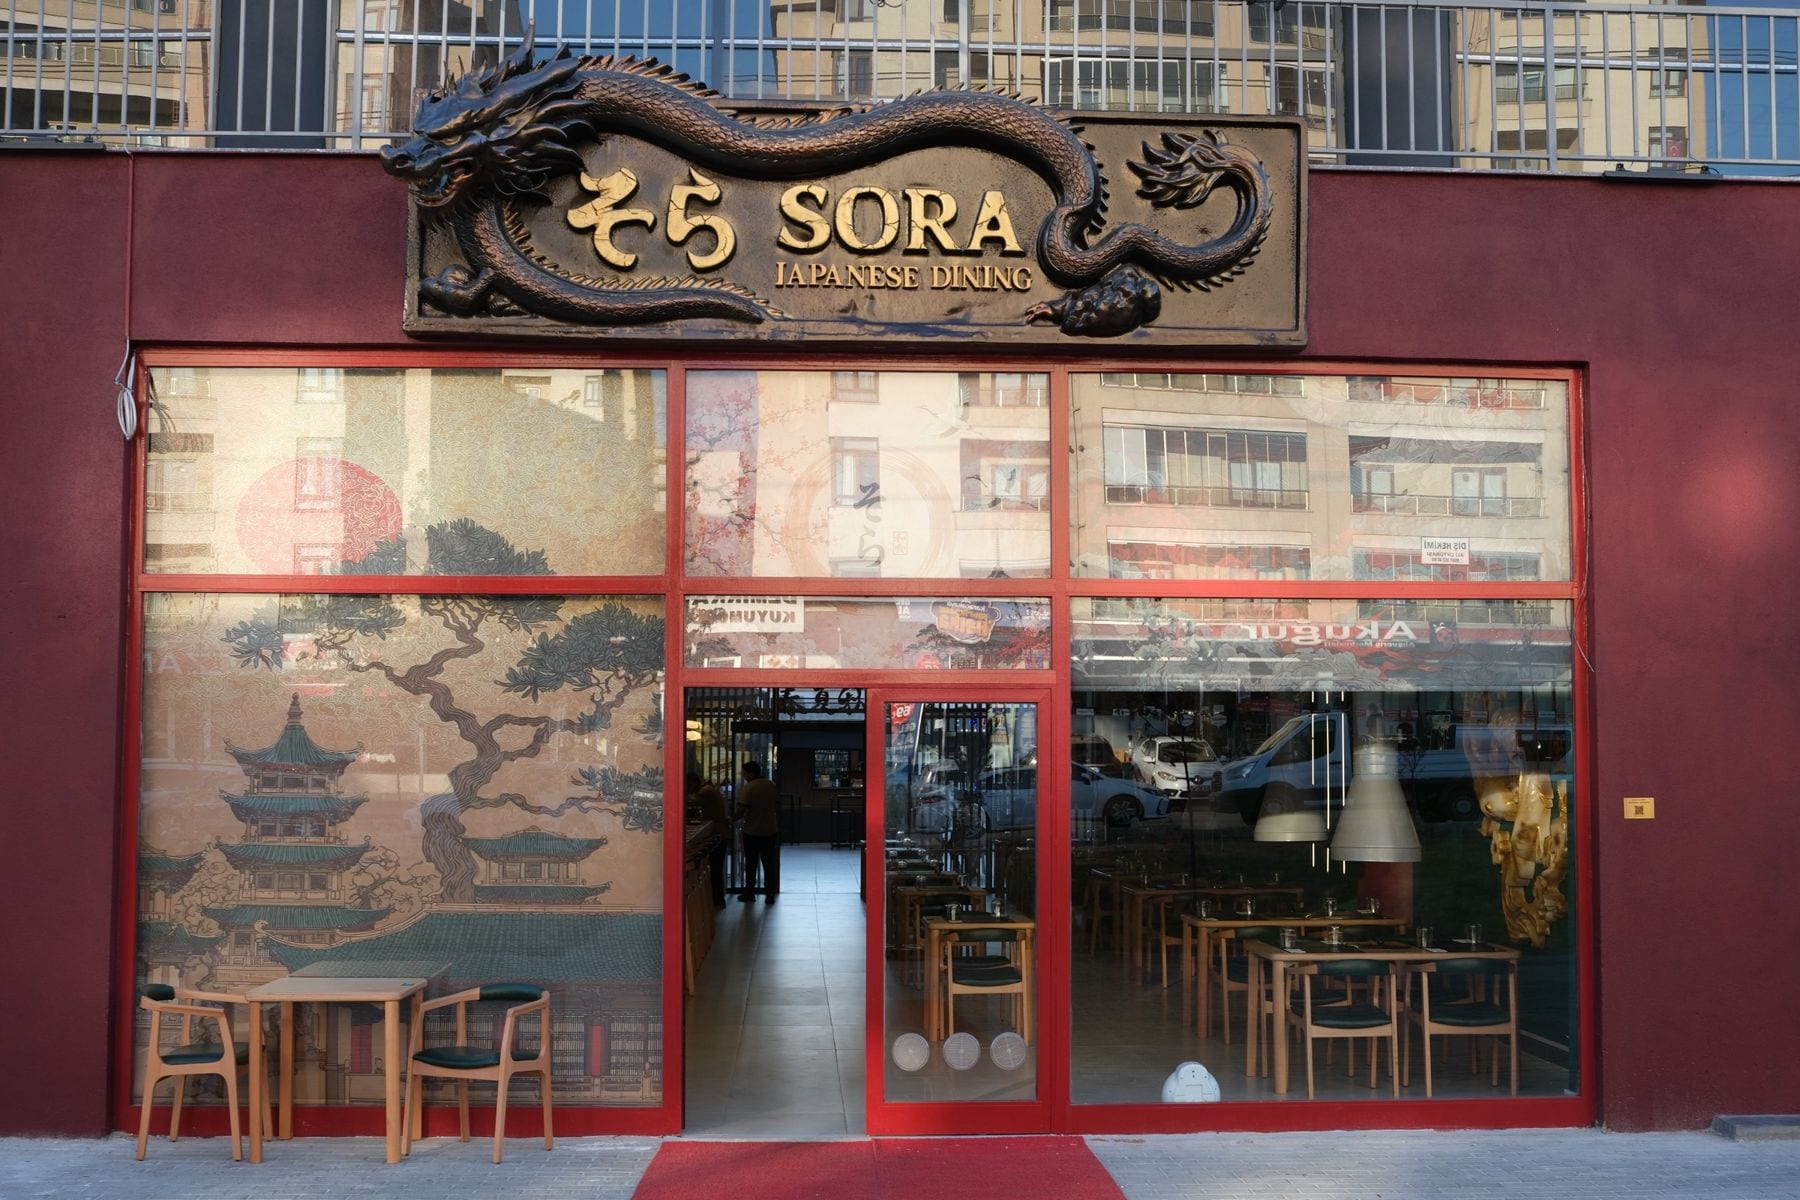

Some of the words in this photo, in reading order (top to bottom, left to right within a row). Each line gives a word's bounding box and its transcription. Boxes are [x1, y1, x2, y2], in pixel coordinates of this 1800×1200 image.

[566, 166, 737, 269] そら
[776, 184, 1027, 256] SORA
[930, 265, 1033, 293] DINING
